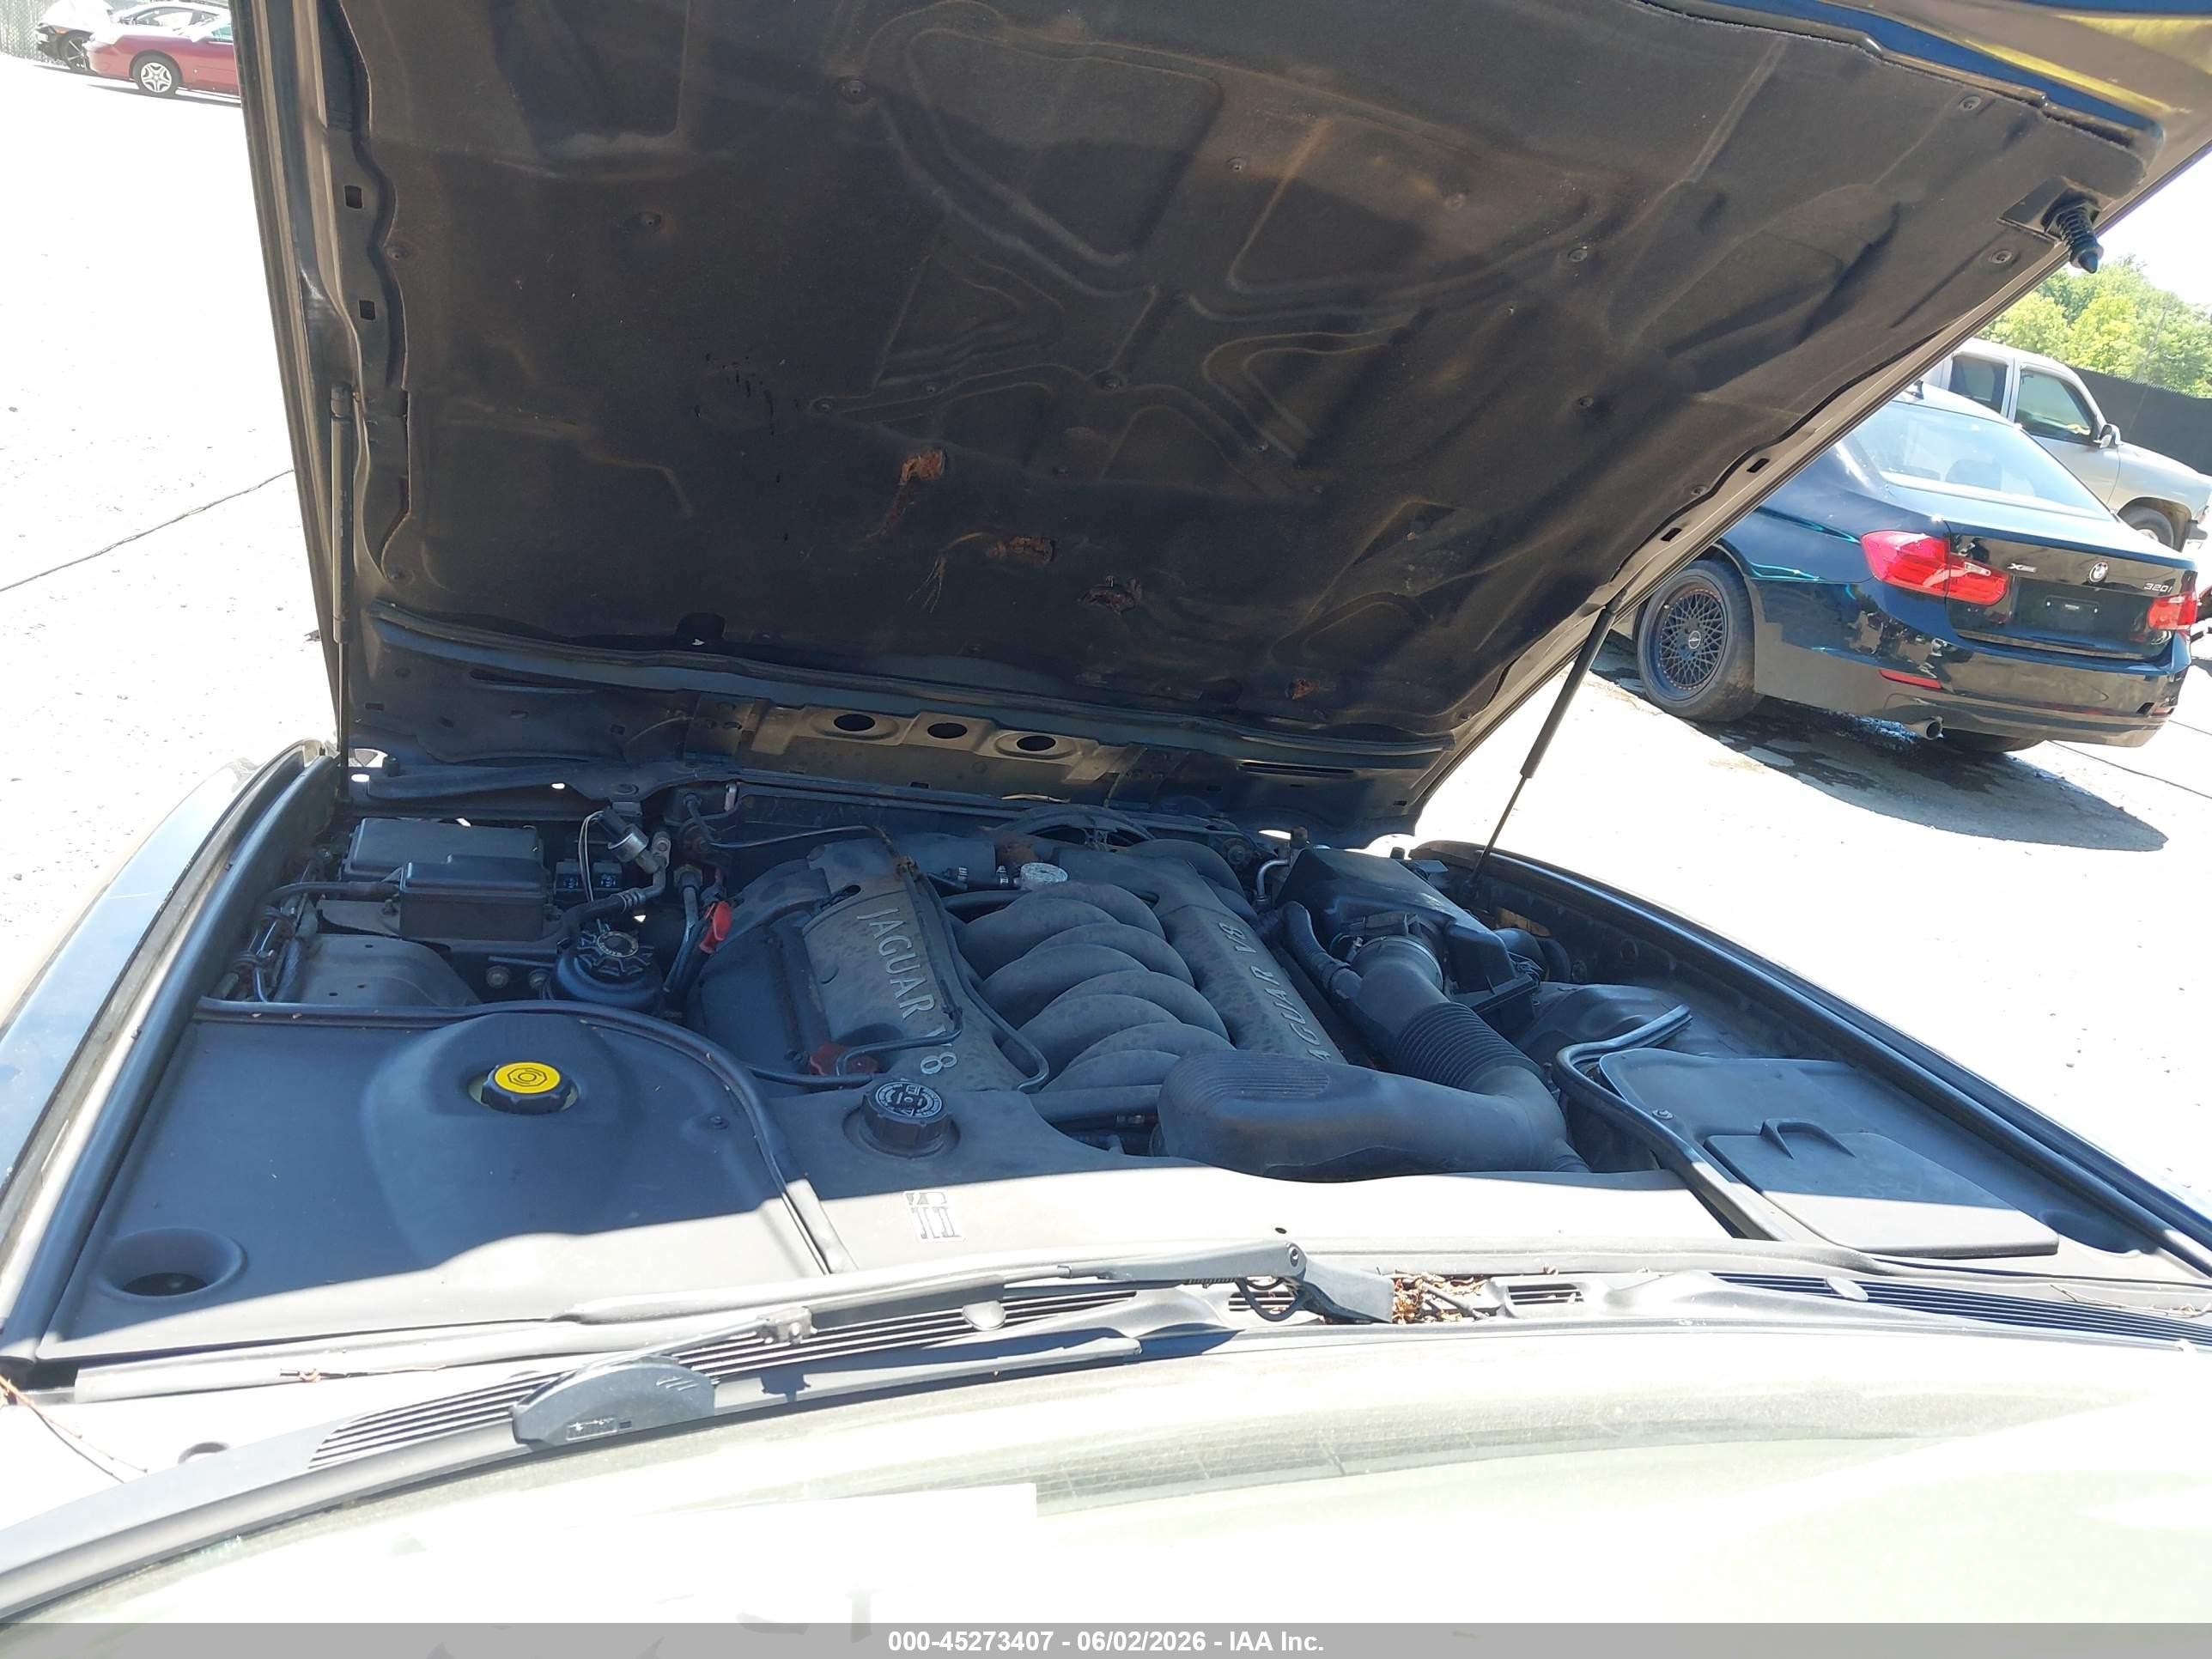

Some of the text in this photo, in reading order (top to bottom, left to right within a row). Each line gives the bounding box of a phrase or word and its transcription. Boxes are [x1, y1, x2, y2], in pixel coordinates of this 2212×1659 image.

[2143, 582, 2172, 592] 320i
[857, 908, 936, 1019] JAGUAR
[1218, 922, 1332, 1062] AGUAR V8
